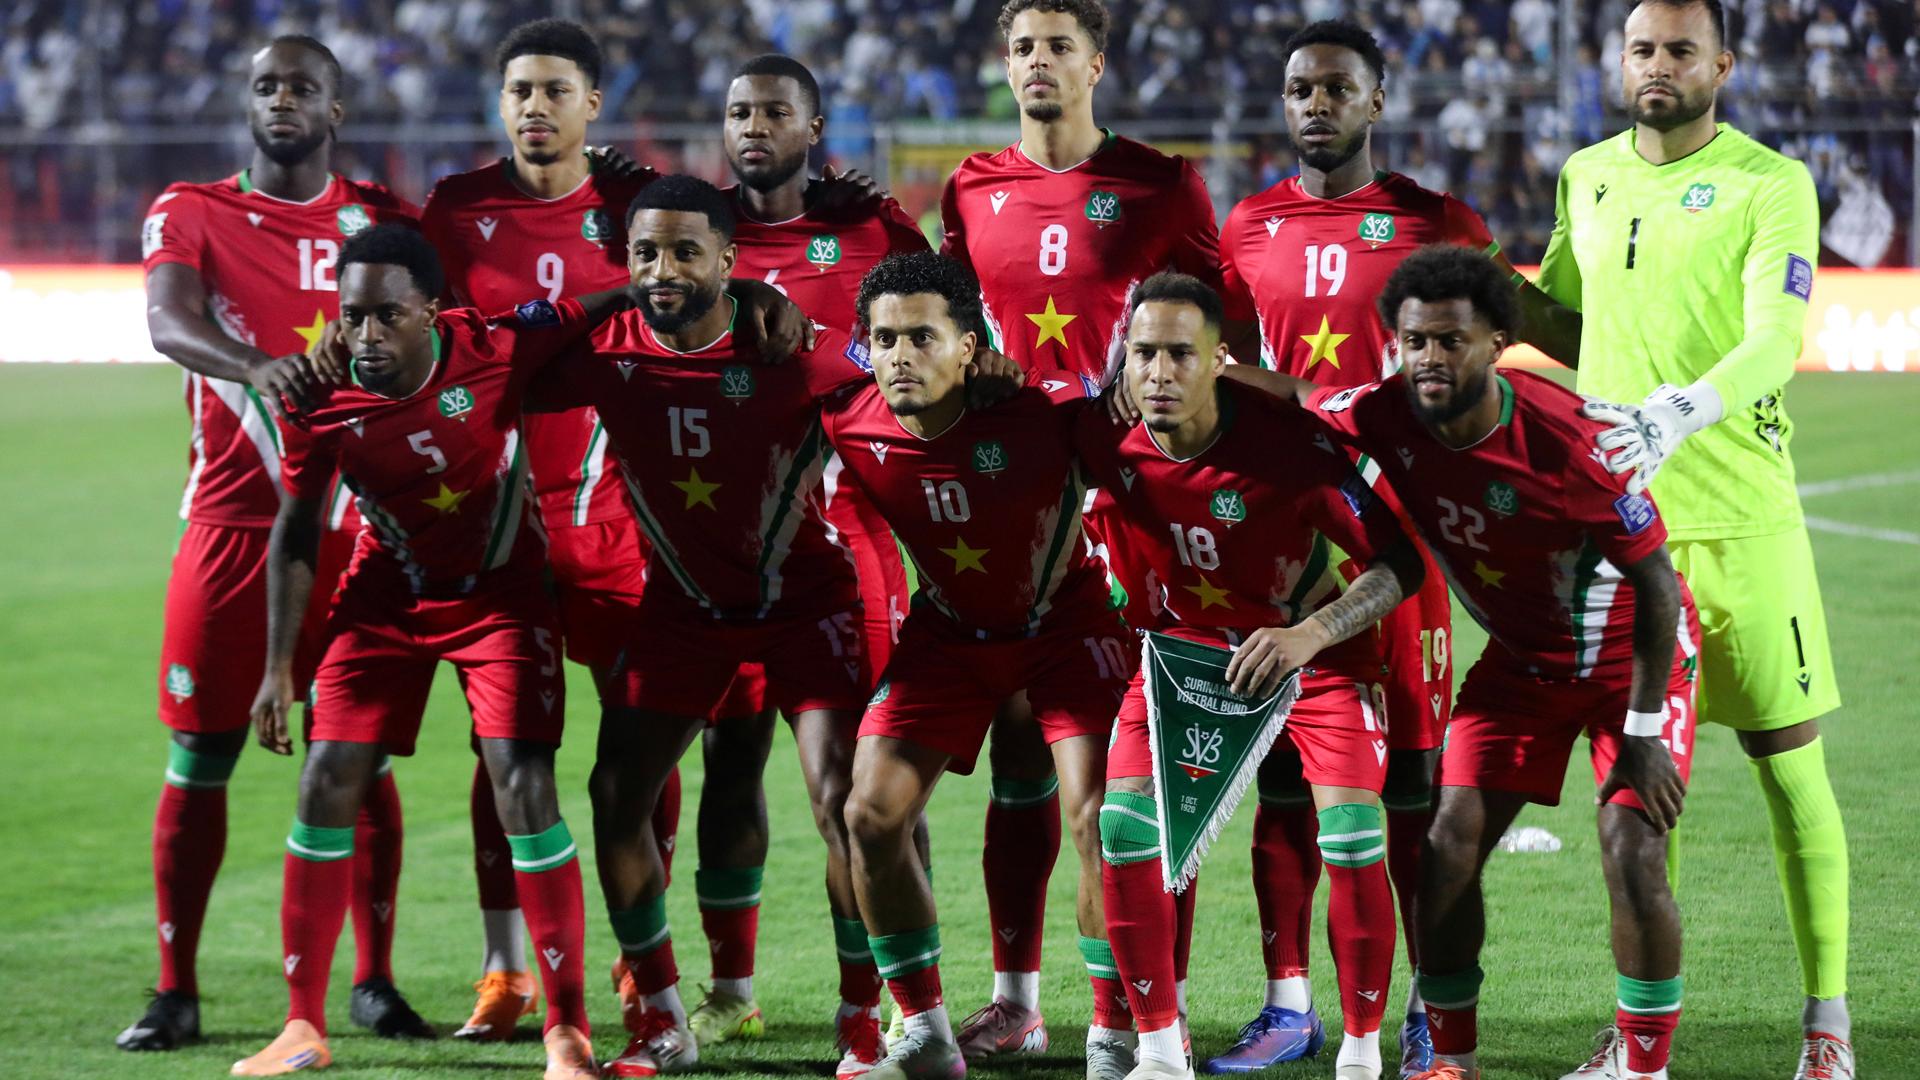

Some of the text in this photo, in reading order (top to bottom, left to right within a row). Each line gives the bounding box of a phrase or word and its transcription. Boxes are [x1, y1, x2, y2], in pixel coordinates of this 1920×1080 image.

[297, 238, 339, 291] 12
[1038, 224, 1068, 276] 8
[1625, 217, 1642, 270] 1
[536, 252, 564, 303] 9
[1304, 243, 1347, 298] 19
[407, 429, 448, 474] 5
[667, 406, 711, 457] 15
[920, 479, 971, 523] 10
[1435, 496, 1490, 552] 22
[1169, 522, 1221, 571] 18
[533, 627, 555, 677] 5
[818, 611, 861, 657] 15
[1083, 637, 1129, 679] 10
[1419, 627, 1448, 683] 19
[1790, 616, 1806, 668] 1
[1220, 700, 1249, 717] BOND
[1180, 803, 1196, 814] 1920
